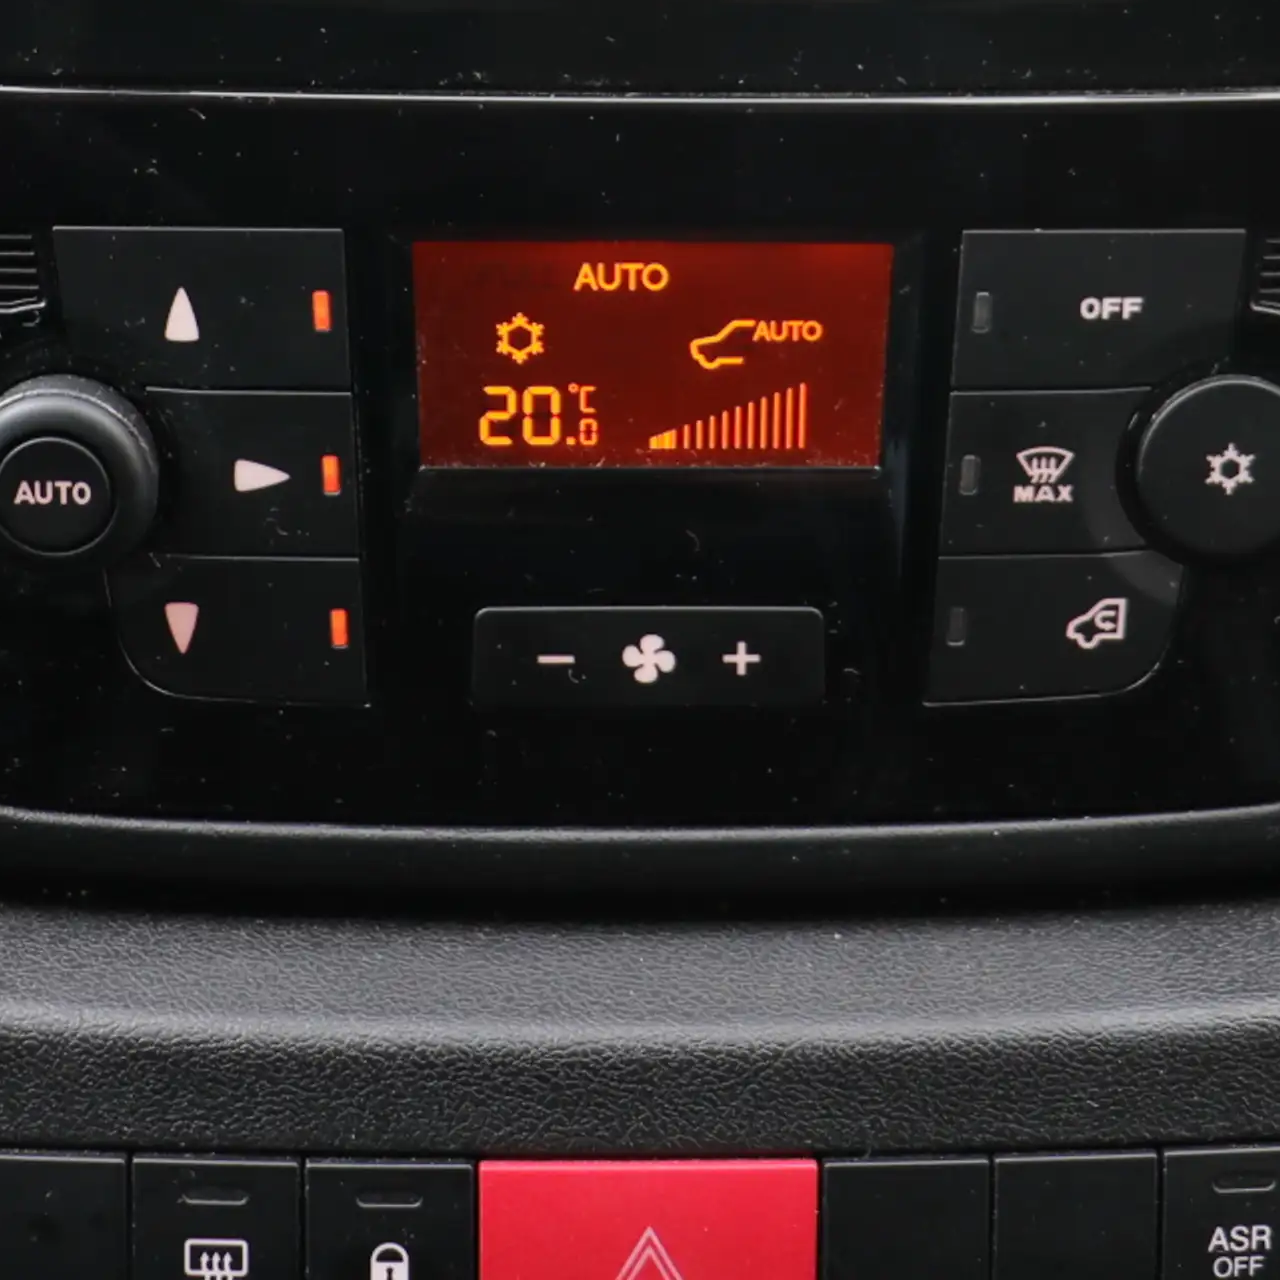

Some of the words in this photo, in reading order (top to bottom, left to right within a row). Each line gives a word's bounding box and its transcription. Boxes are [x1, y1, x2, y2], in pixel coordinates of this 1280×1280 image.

[573, 262, 669, 291] AUTO
[1079, 297, 1144, 320] OFF
[752, 319, 824, 343] AUTO
[13, 480, 92, 506] AUTO
[1013, 485, 1073, 503] MAX
[1207, 1225, 1272, 1253] ASR
[1213, 1255, 1265, 1278] OFF
